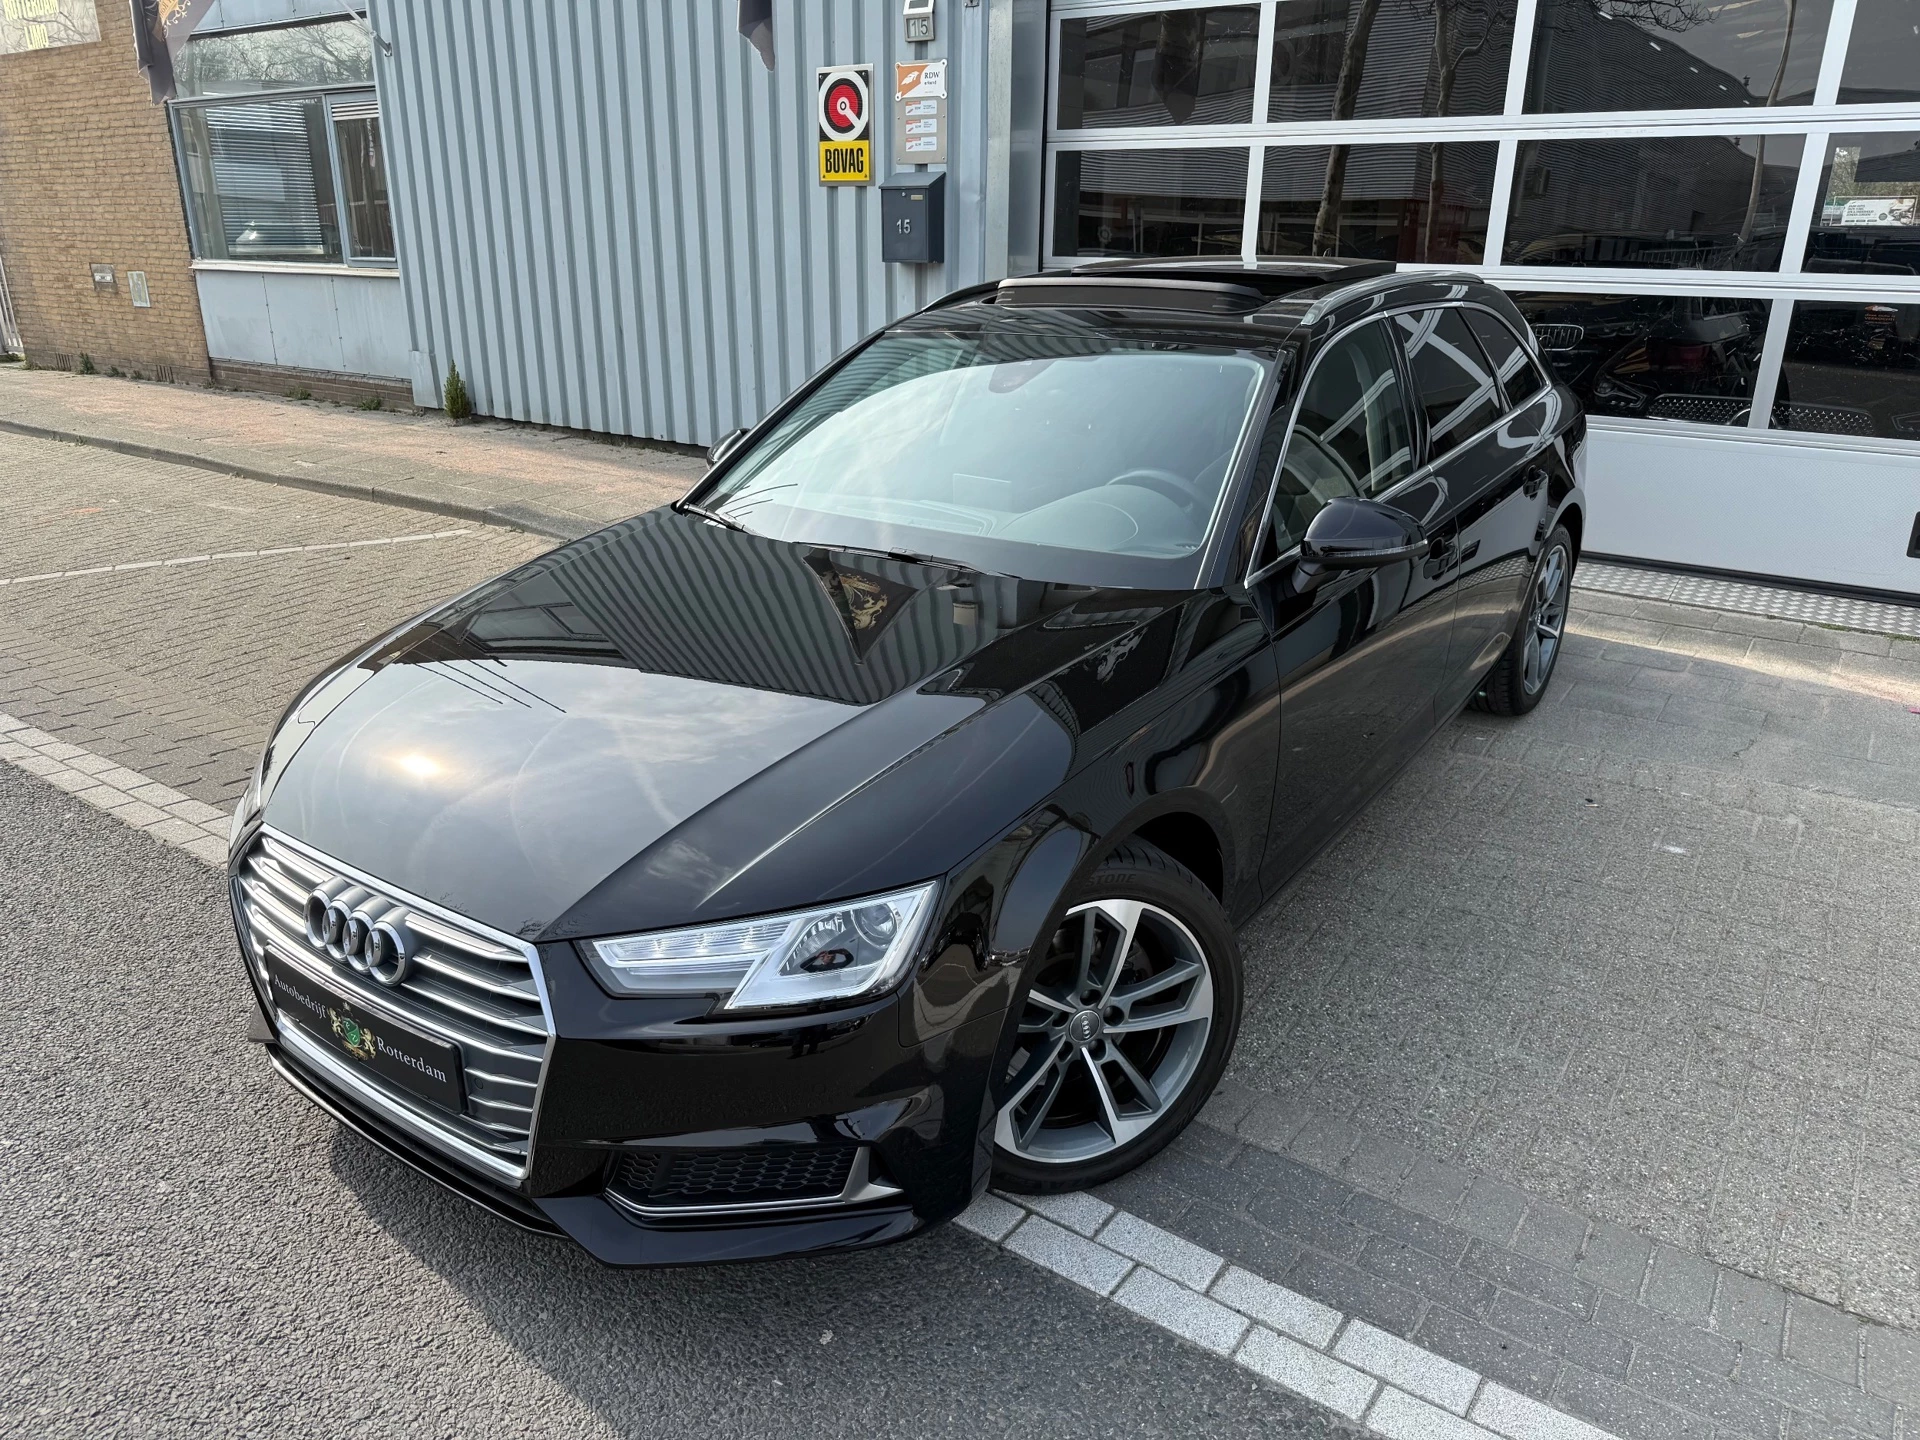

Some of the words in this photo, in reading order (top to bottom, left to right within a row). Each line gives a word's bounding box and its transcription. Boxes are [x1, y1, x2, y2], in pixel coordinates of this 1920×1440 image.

[911, 19, 928, 36] 15
[924, 71, 939, 80] RDW
[824, 147, 864, 174] BOVAG
[896, 218, 911, 235] 15
[274, 974, 328, 1020] Autobedrijf
[376, 1037, 447, 1083] Rotterdam
